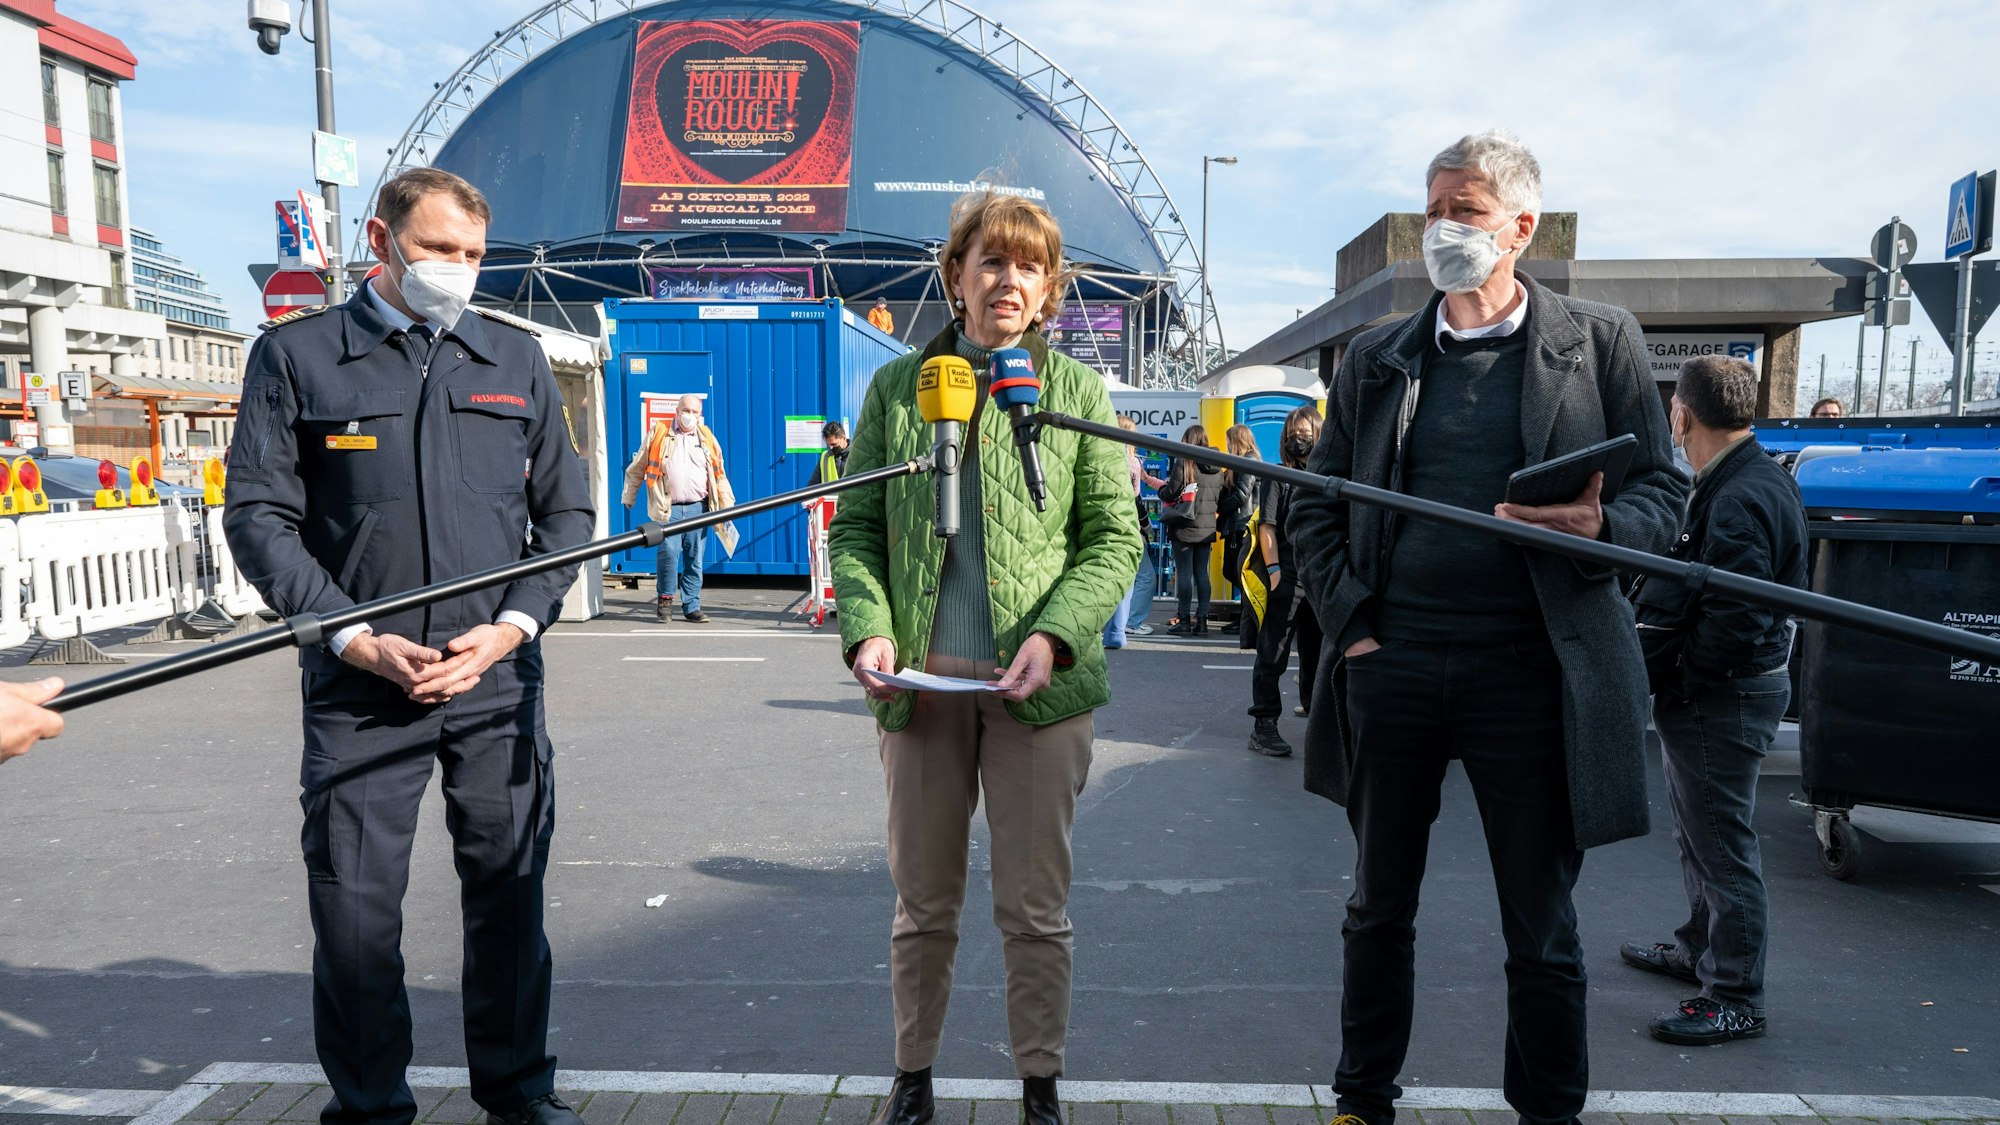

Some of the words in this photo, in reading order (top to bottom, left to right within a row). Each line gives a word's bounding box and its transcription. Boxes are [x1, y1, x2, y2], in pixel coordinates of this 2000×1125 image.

[687, 71, 783, 100] MOULIN
[874, 180, 1046, 200] www.musical-dome.de
[658, 192, 683, 201] AB
[688, 193, 772, 202] OKTOBER
[776, 193, 810, 202] 2022
[650, 204, 674, 213] IM
[679, 204, 759, 213] MUSICAL
[764, 205, 816, 214] DOME
[658, 279, 730, 298] Spektakuläre
[735, 280, 806, 299] Unterhaltung
[1005, 359, 1028, 368] WDR
[951, 369, 969, 377] Radio
[955, 377, 969, 385] Köln
[68, 380, 79, 396] E
[470, 394, 526, 407] FEUERWEHR
